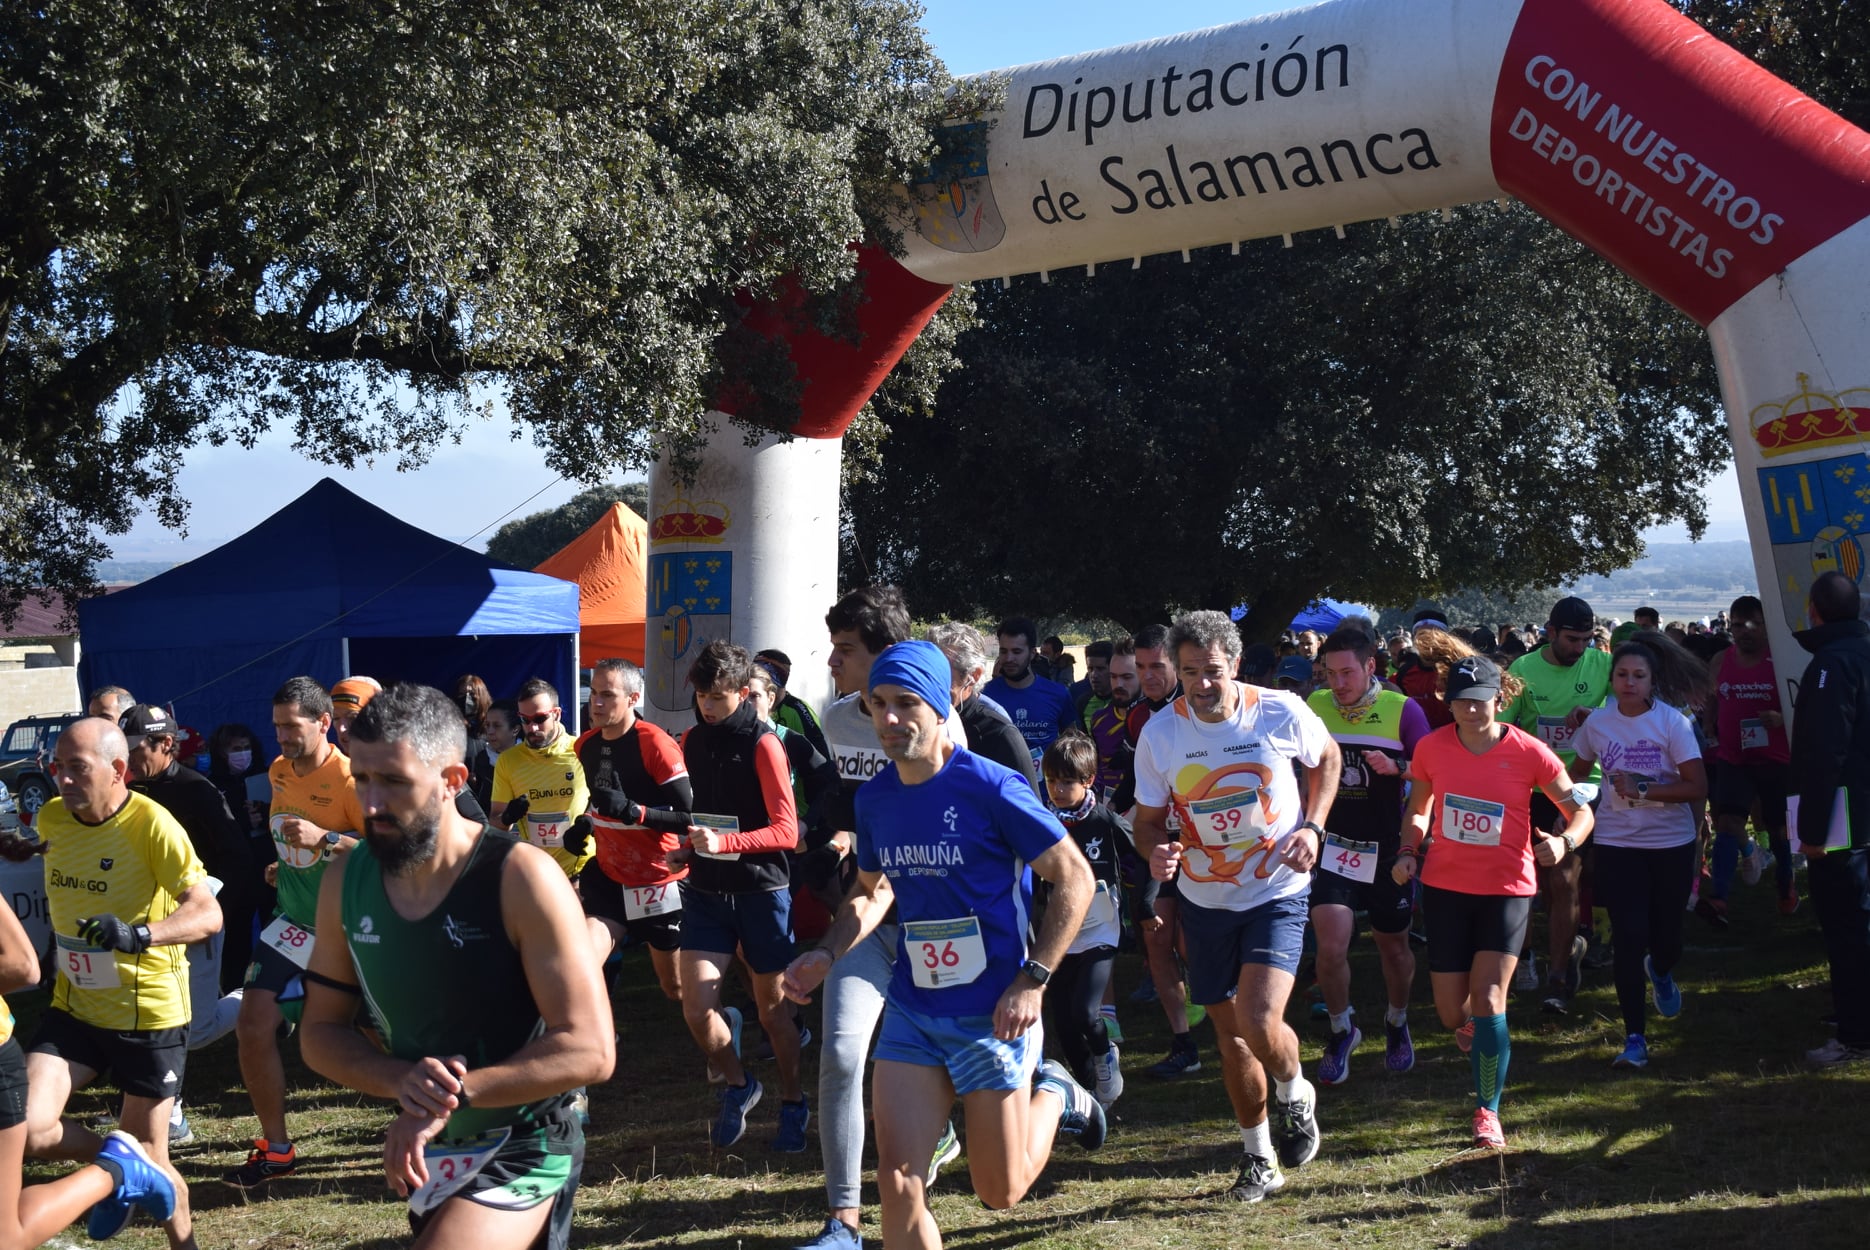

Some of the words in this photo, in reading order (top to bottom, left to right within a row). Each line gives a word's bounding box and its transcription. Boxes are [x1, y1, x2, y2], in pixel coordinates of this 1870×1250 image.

[1023, 35, 1349, 145] Diputación
[1525, 55, 1602, 121] CON
[1594, 104, 1784, 246] NUESTROS
[1032, 180, 1086, 225] de
[1099, 127, 1441, 215] Salamanca
[1508, 107, 1734, 279] DEPORTISTAS
[1544, 726, 1574, 741] 159
[837, 752, 888, 777] adida
[538, 824, 558, 837] 54
[1210, 809, 1242, 831] 39
[1452, 810, 1491, 833] 180
[880, 847, 892, 867] LA
[895, 841, 964, 867] ARMUÑA
[1336, 851, 1361, 868] 46
[87, 880, 107, 893] GO
[633, 884, 668, 906] 127
[280, 925, 308, 948] 58
[68, 952, 92, 974] 51
[922, 941, 959, 969] 36
